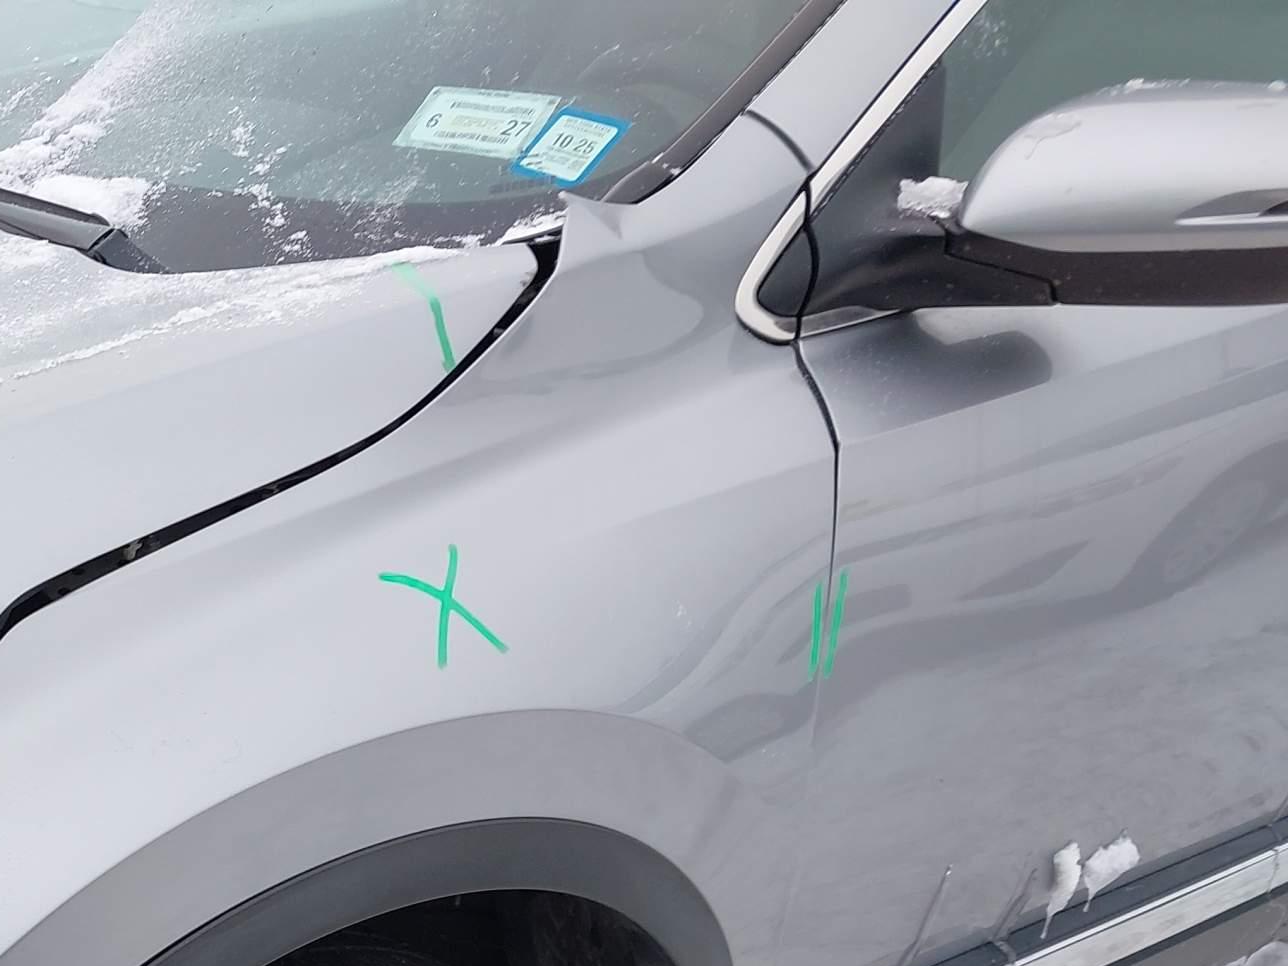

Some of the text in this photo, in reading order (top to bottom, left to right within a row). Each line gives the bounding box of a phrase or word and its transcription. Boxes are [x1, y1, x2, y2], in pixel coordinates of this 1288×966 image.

[425, 113, 442, 128] 6
[500, 119, 531, 137] 27
[552, 132, 596, 155] 10 25
